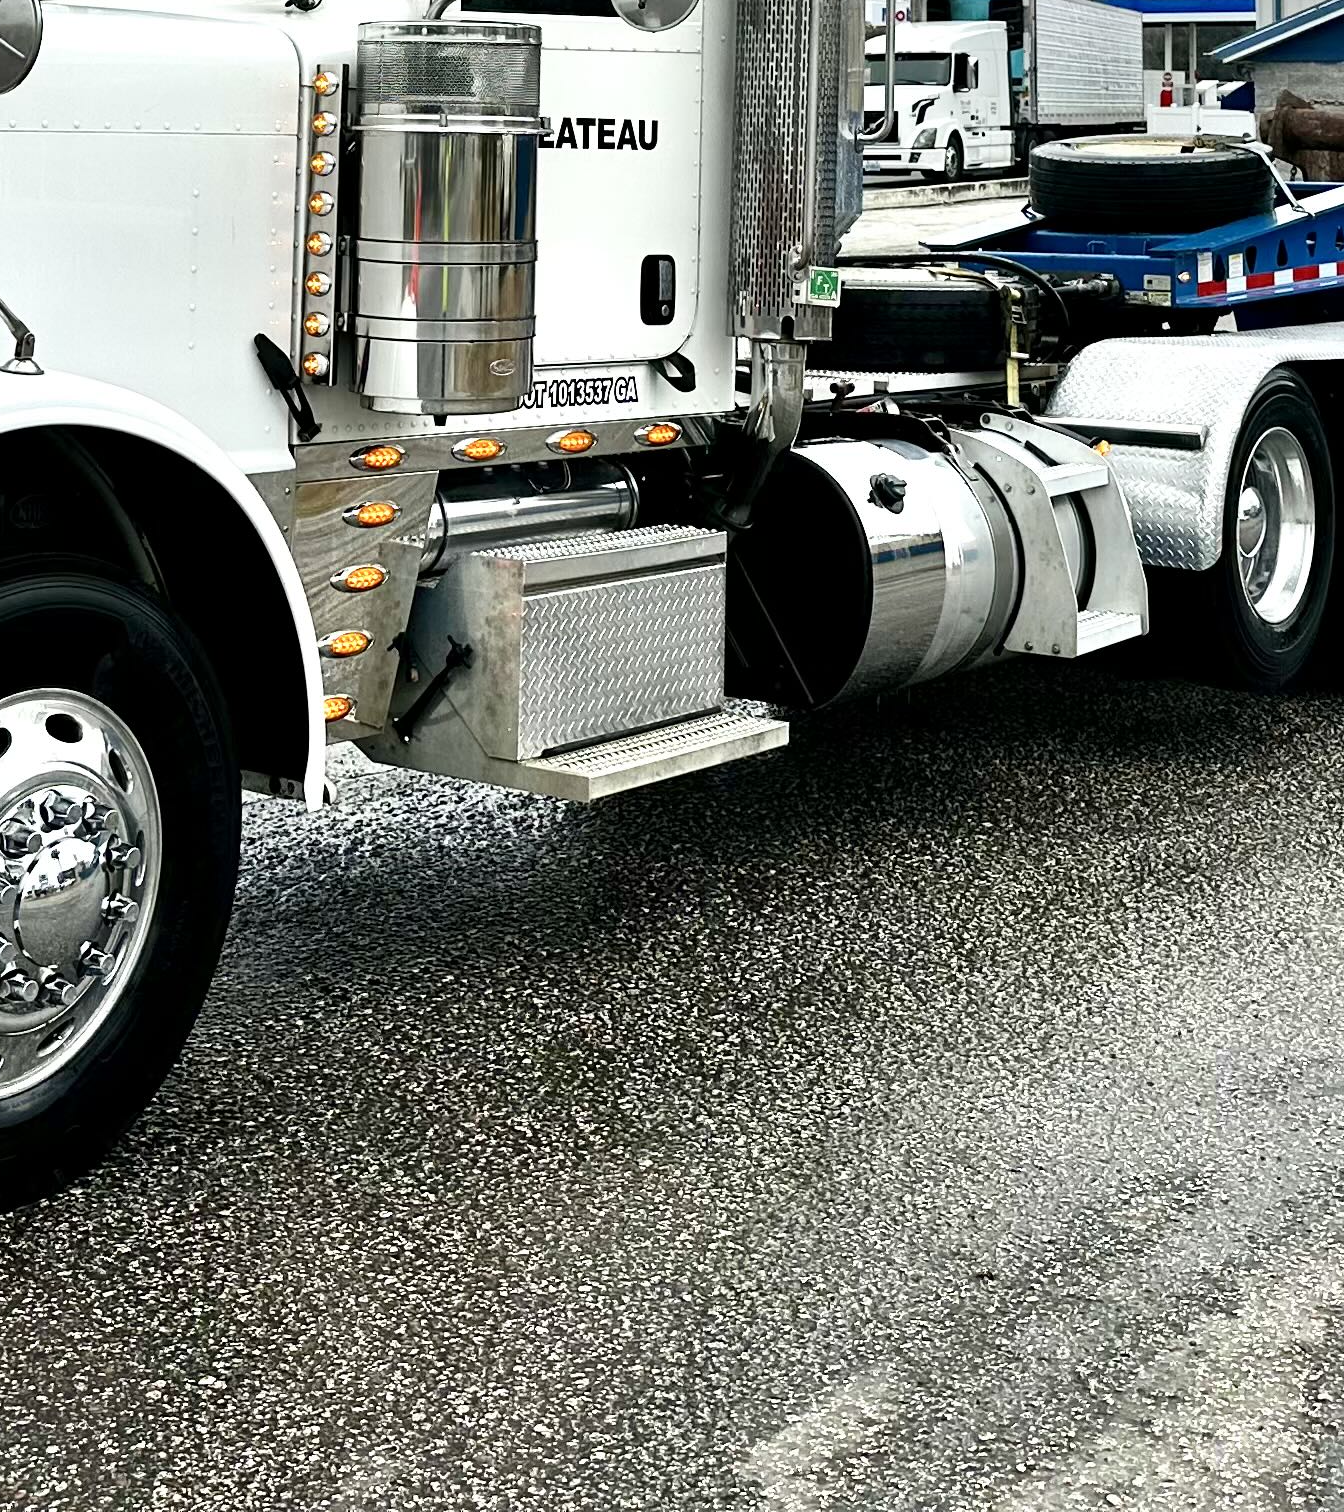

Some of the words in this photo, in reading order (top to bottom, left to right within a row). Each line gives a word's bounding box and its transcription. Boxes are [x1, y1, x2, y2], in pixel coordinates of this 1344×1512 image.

[538, 116, 659, 151] LATEAU
[517, 380, 548, 409] OT
[548, 377, 613, 408] 1013537
[614, 375, 639, 404] GA
